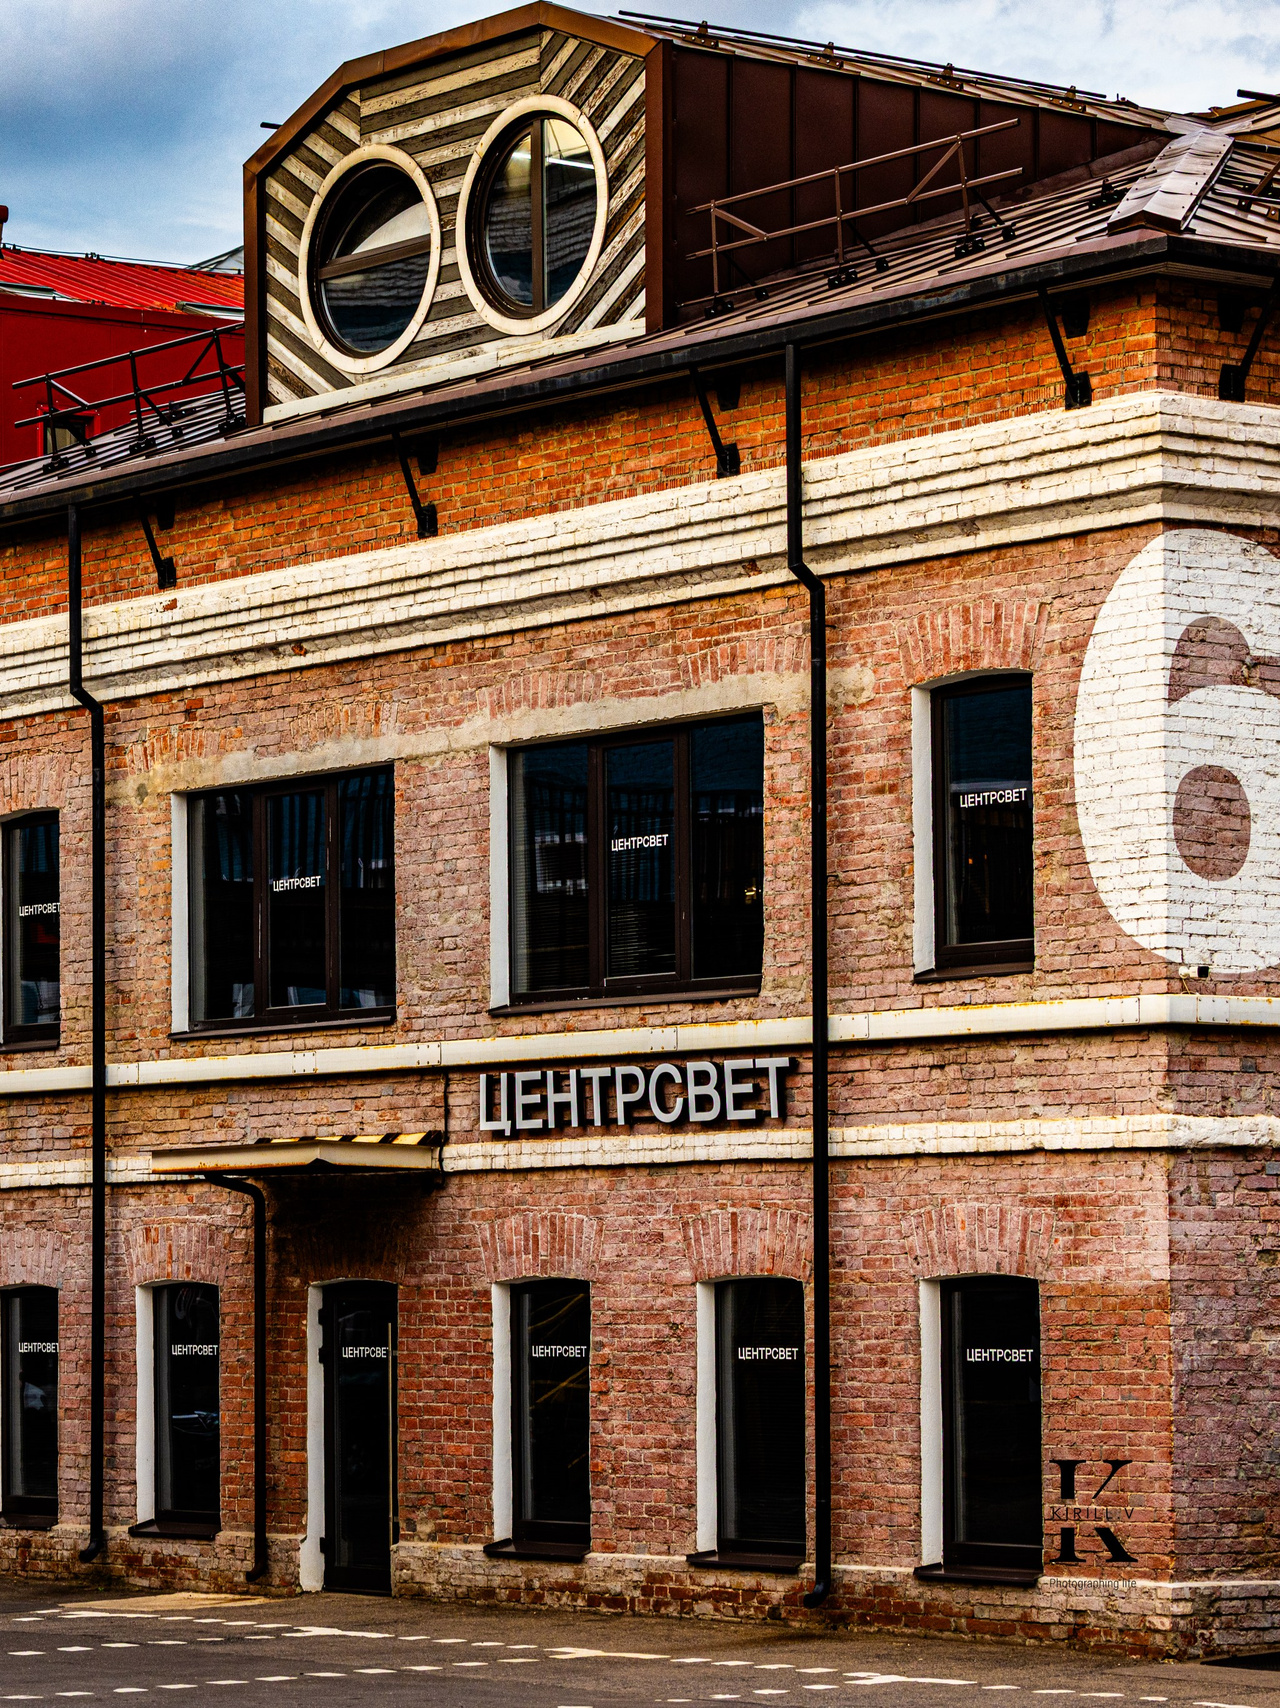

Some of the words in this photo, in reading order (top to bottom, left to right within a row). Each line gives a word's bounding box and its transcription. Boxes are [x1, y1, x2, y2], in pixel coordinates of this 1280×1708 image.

[1073, 528, 1280, 974] 6
[960, 787, 1027, 808] ЦЕНТРСВЕТ
[611, 833, 669, 852] ЦЕНТРСВЕТ
[272, 875, 321, 892] ЦЕНТРСВЕТ
[19, 902, 60, 917] ЦЕНТРСВЕТ
[479, 1057, 790, 1136] ЦЕНТРСВЕТ
[18, 1342, 59, 1353] ЦЕНТРСВЕТ
[171, 1344, 218, 1356] ЦЕНТРСВЕТ
[532, 1345, 587, 1358] ЦЕНТРСВЕТ
[738, 1347, 799, 1360] ЦЕНТРСВЕТ
[966, 1348, 1034, 1362] ЦЕНТРСВЕТ
